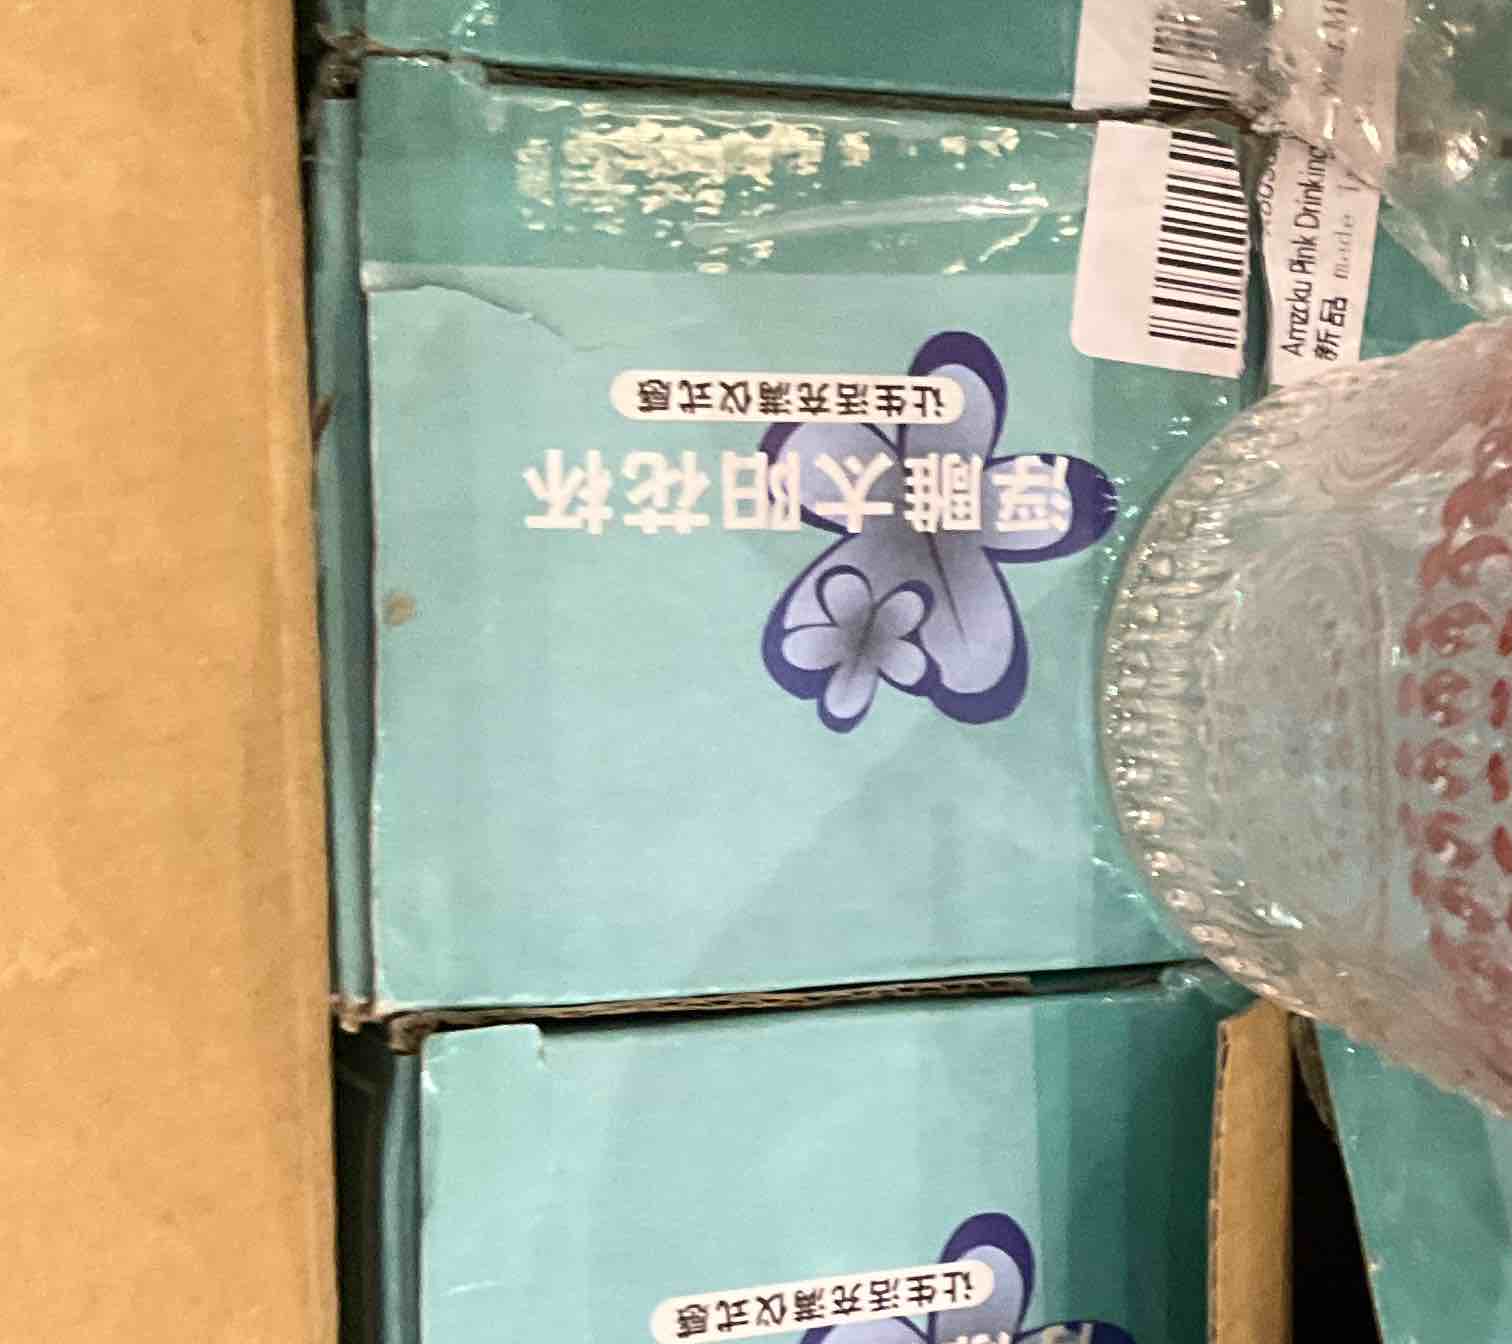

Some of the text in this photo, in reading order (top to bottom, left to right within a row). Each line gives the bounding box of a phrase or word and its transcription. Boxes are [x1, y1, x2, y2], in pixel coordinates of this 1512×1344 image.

[1295, 146, 1332, 230] Drinking
[1315, 296, 1347, 361] 新品
[636, 378, 947, 420] 让生活充满仪式感
[523, 449, 1069, 535] 浮雕太阳花杯
[676, 1269, 977, 1341] 让生活充满仪式感
